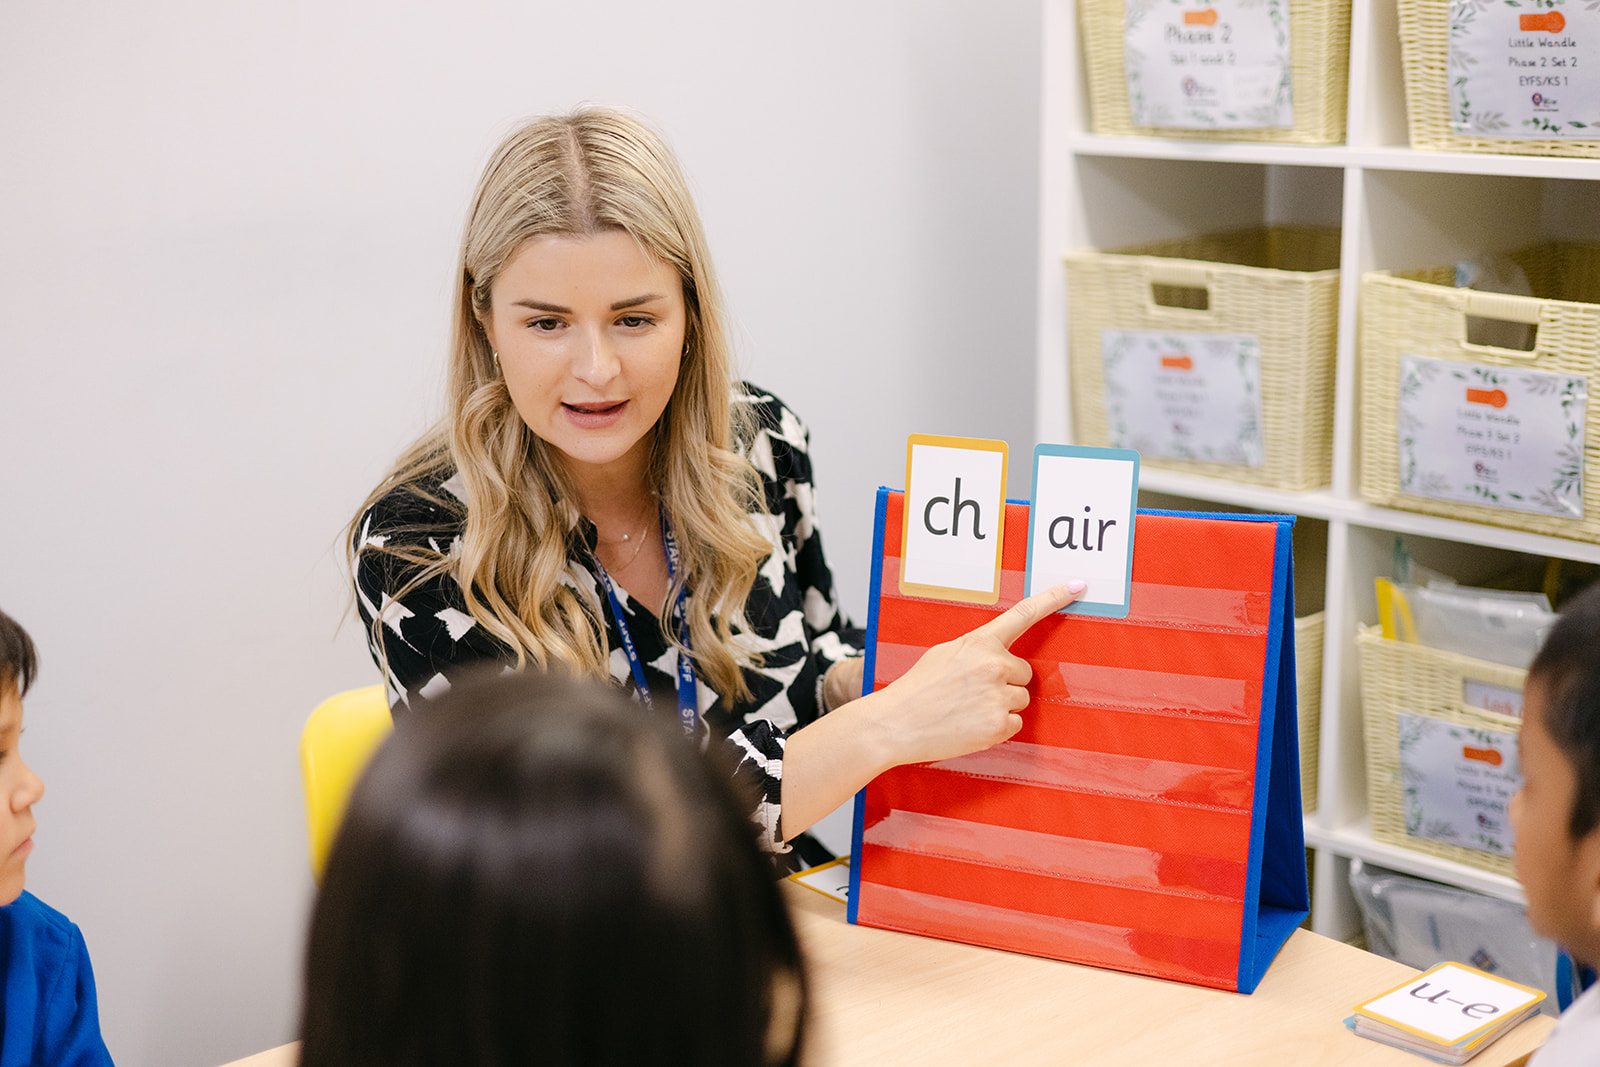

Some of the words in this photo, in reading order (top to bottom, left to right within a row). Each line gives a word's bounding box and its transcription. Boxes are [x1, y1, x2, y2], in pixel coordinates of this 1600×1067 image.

[1222, 23, 1233, 43] 2
[1508, 38, 1534, 48] Little
[1538, 38, 1576, 48] Wandle
[1508, 57, 1536, 67] Phase
[1540, 57, 1547, 67] 2
[1551, 57, 1567, 67] Set
[1570, 57, 1578, 67] 2
[1519, 76, 1560, 86] EYFS/KS
[923, 477, 986, 540] ch
[1048, 505, 1117, 551] air
[618, 619, 637, 661] STAFF
[1410, 982, 1499, 1020] u-e
